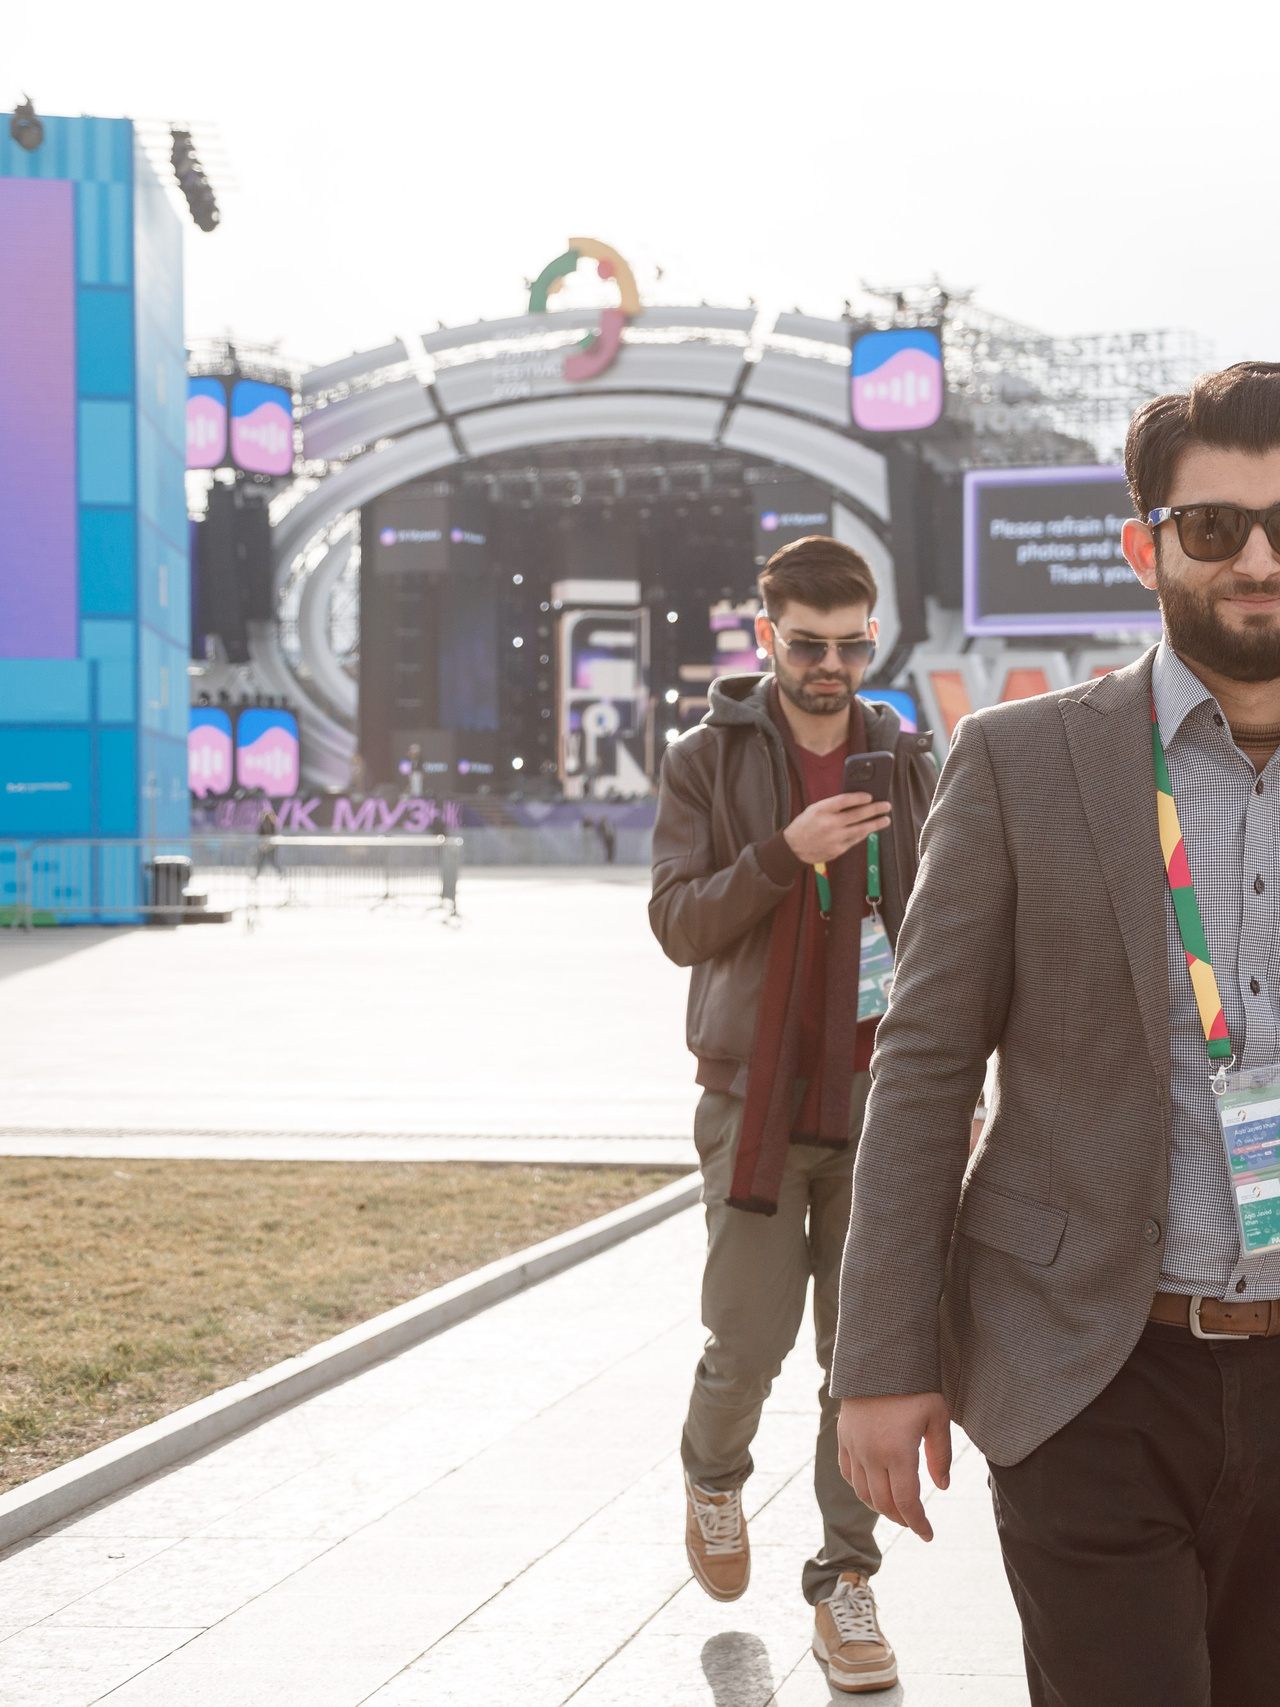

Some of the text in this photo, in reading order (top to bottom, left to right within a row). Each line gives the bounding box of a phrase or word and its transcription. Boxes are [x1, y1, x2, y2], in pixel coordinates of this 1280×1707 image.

[990, 518, 1044, 538] Please
[1047, 515, 1103, 537] refrain
[1017, 541, 1076, 564] photos
[1079, 539, 1112, 560] and
[1049, 563, 1100, 584] Thank
